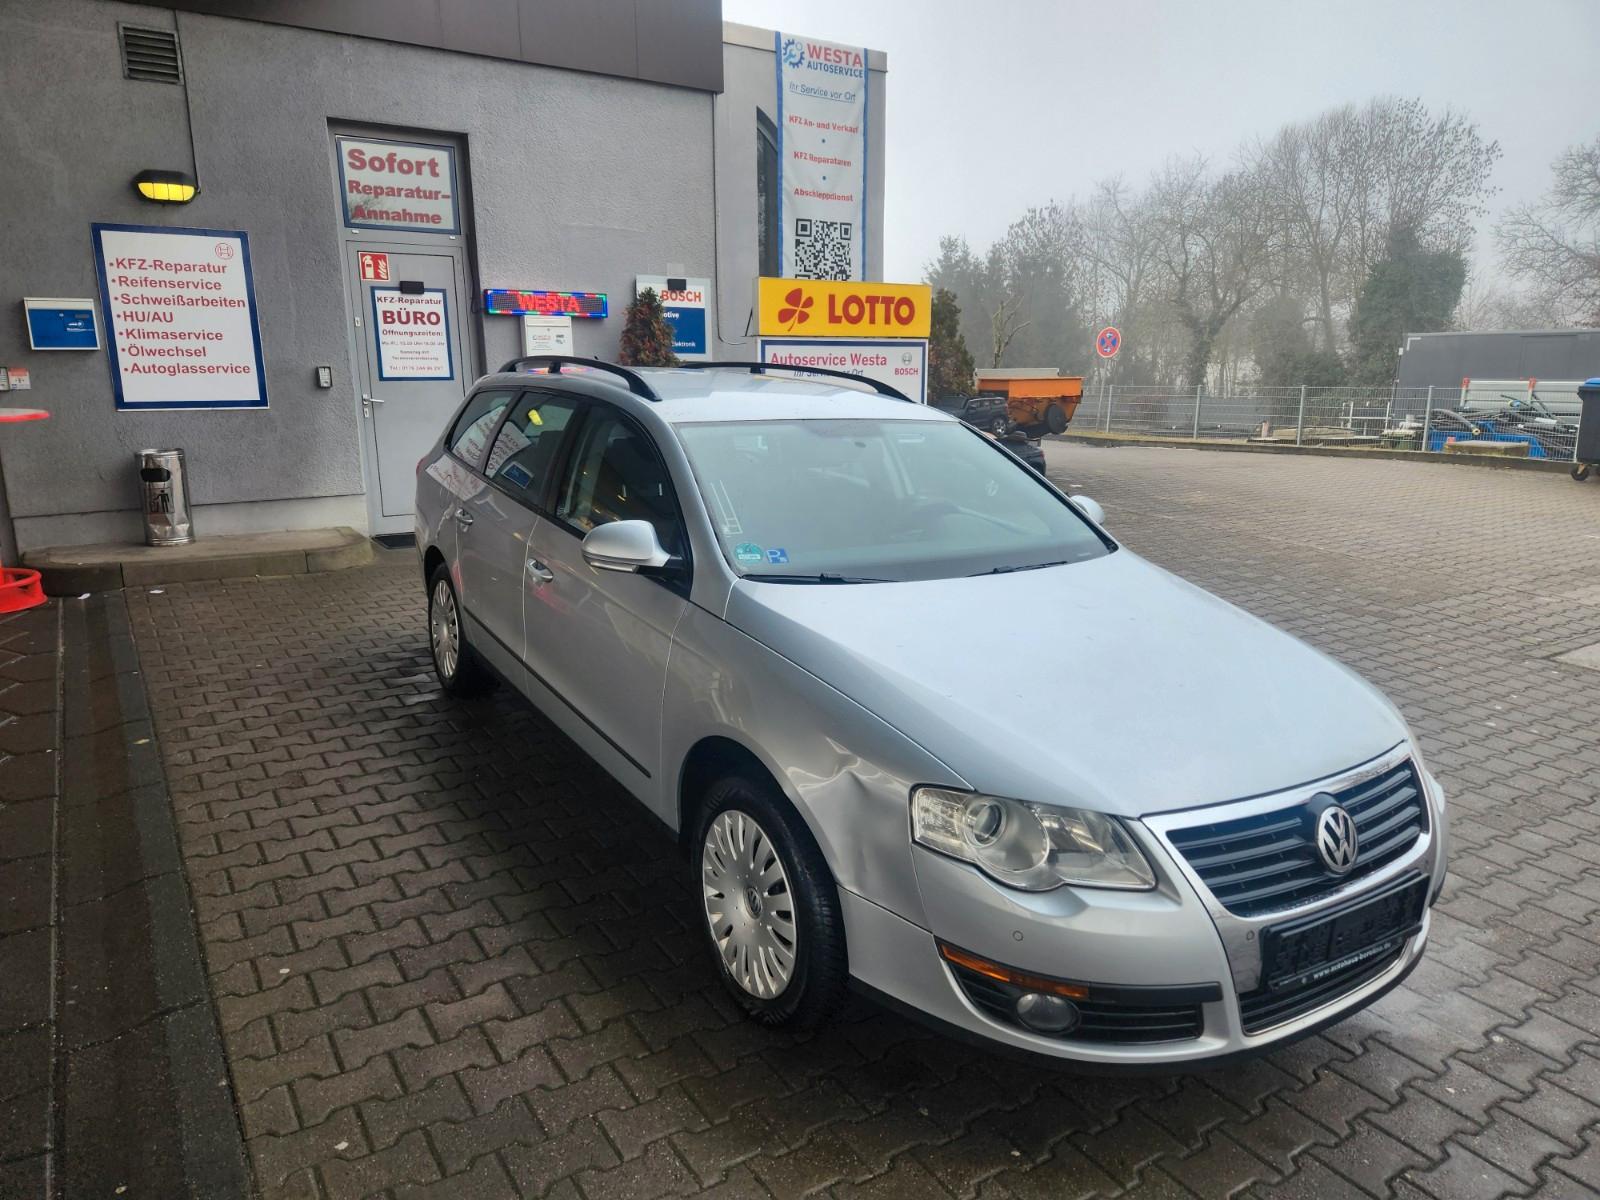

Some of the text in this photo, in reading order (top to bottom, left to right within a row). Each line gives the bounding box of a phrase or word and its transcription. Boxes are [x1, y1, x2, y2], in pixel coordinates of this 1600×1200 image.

[807, 43, 863, 68] WESTA
[807, 61, 863, 78] AUTOSERVICE
[789, 82, 856, 102] Ihr Service vor Ort
[788, 115, 803, 125] KFZ
[816, 122, 830, 130] und
[348, 148, 440, 177] Sofort
[793, 151, 808, 160] KFZ
[348, 180, 450, 200] Reparatur-
[794, 187, 853, 202] Abschleppdienst
[351, 205, 442, 224] Annahme
[116, 258, 227, 274] KFZ-Reparatur
[118, 276, 222, 290] Reifenservice
[121, 294, 246, 308] Schweißarbeiten
[377, 296, 442, 305] KFZ-Reparatur
[661, 290, 702, 302] BOSCH
[518, 295, 580, 313] WESTA
[828, 294, 915, 326] LOTTO
[123, 311, 174, 323] HU/AU
[382, 308, 441, 325] BÜRO
[663, 311, 679, 320] otive
[125, 329, 223, 341] Klimaservice
[128, 344, 207, 357] Ölwechsel
[770, 352, 887, 366] Autoservice Westa
[130, 363, 250, 376] Autoglasservice
[852, 368, 863, 376] Ort
[894, 368, 919, 376] BOSCH
